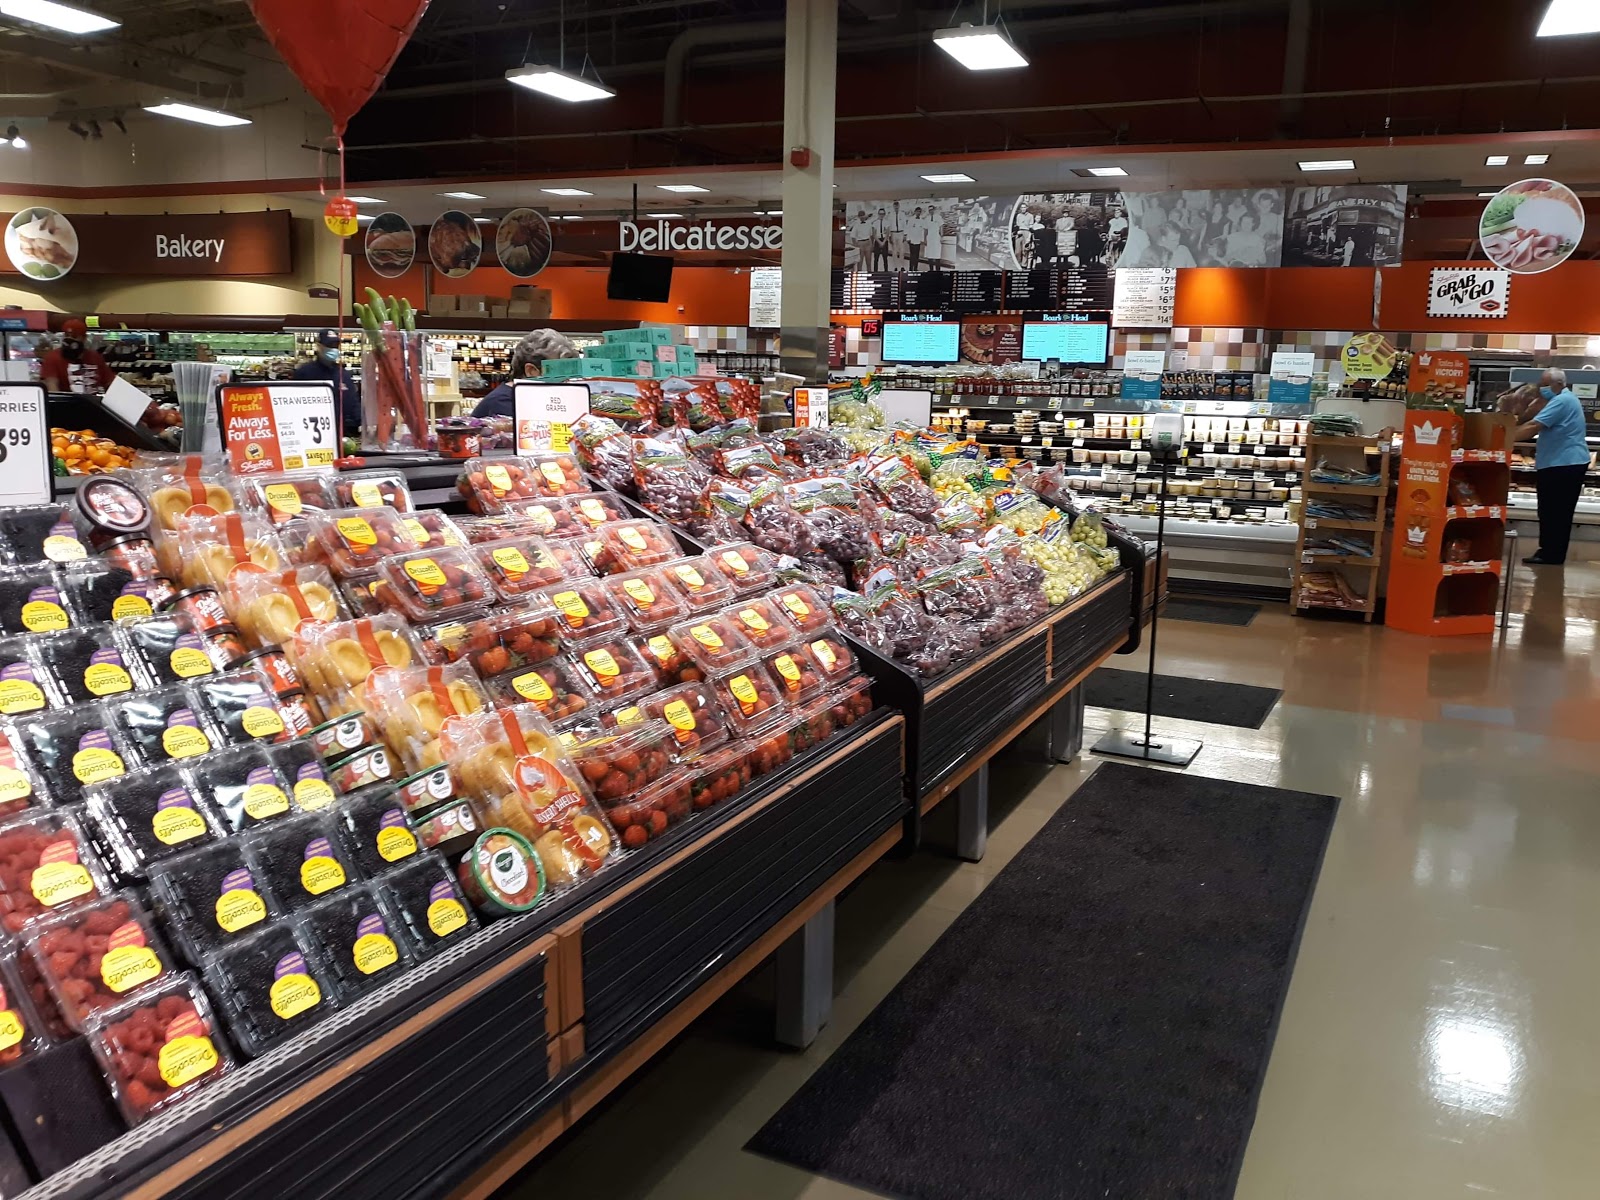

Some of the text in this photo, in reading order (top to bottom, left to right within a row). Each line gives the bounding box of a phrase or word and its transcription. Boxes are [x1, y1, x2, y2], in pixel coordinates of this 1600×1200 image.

[1336, 198, 1379, 208] AVERLY
[619, 219, 783, 251] Delicatesse
[156, 233, 225, 263] Bakery
[1436, 274, 1476, 298] GRAB
[1469, 279, 1494, 300] GO
[900, 313, 942, 322] Boar's Head
[1042, 313, 1089, 322] Boar's Head
[863, 322, 878, 334] 05
[1435, 368, 1464, 378] VICTORY!
[228, 392, 264, 405] Always
[273, 395, 332, 406] STRAWBERRIES
[550, 396, 561, 404] RED
[0, 402, 37, 412] RRIES
[231, 402, 262, 413] Fresh.
[545, 404, 567, 412] GRAPES
[228, 416, 270, 430] Always
[227, 428, 275, 441] For Less.
[533, 429, 552, 440] PLUS
[554, 792, 581, 812] SHELLS
